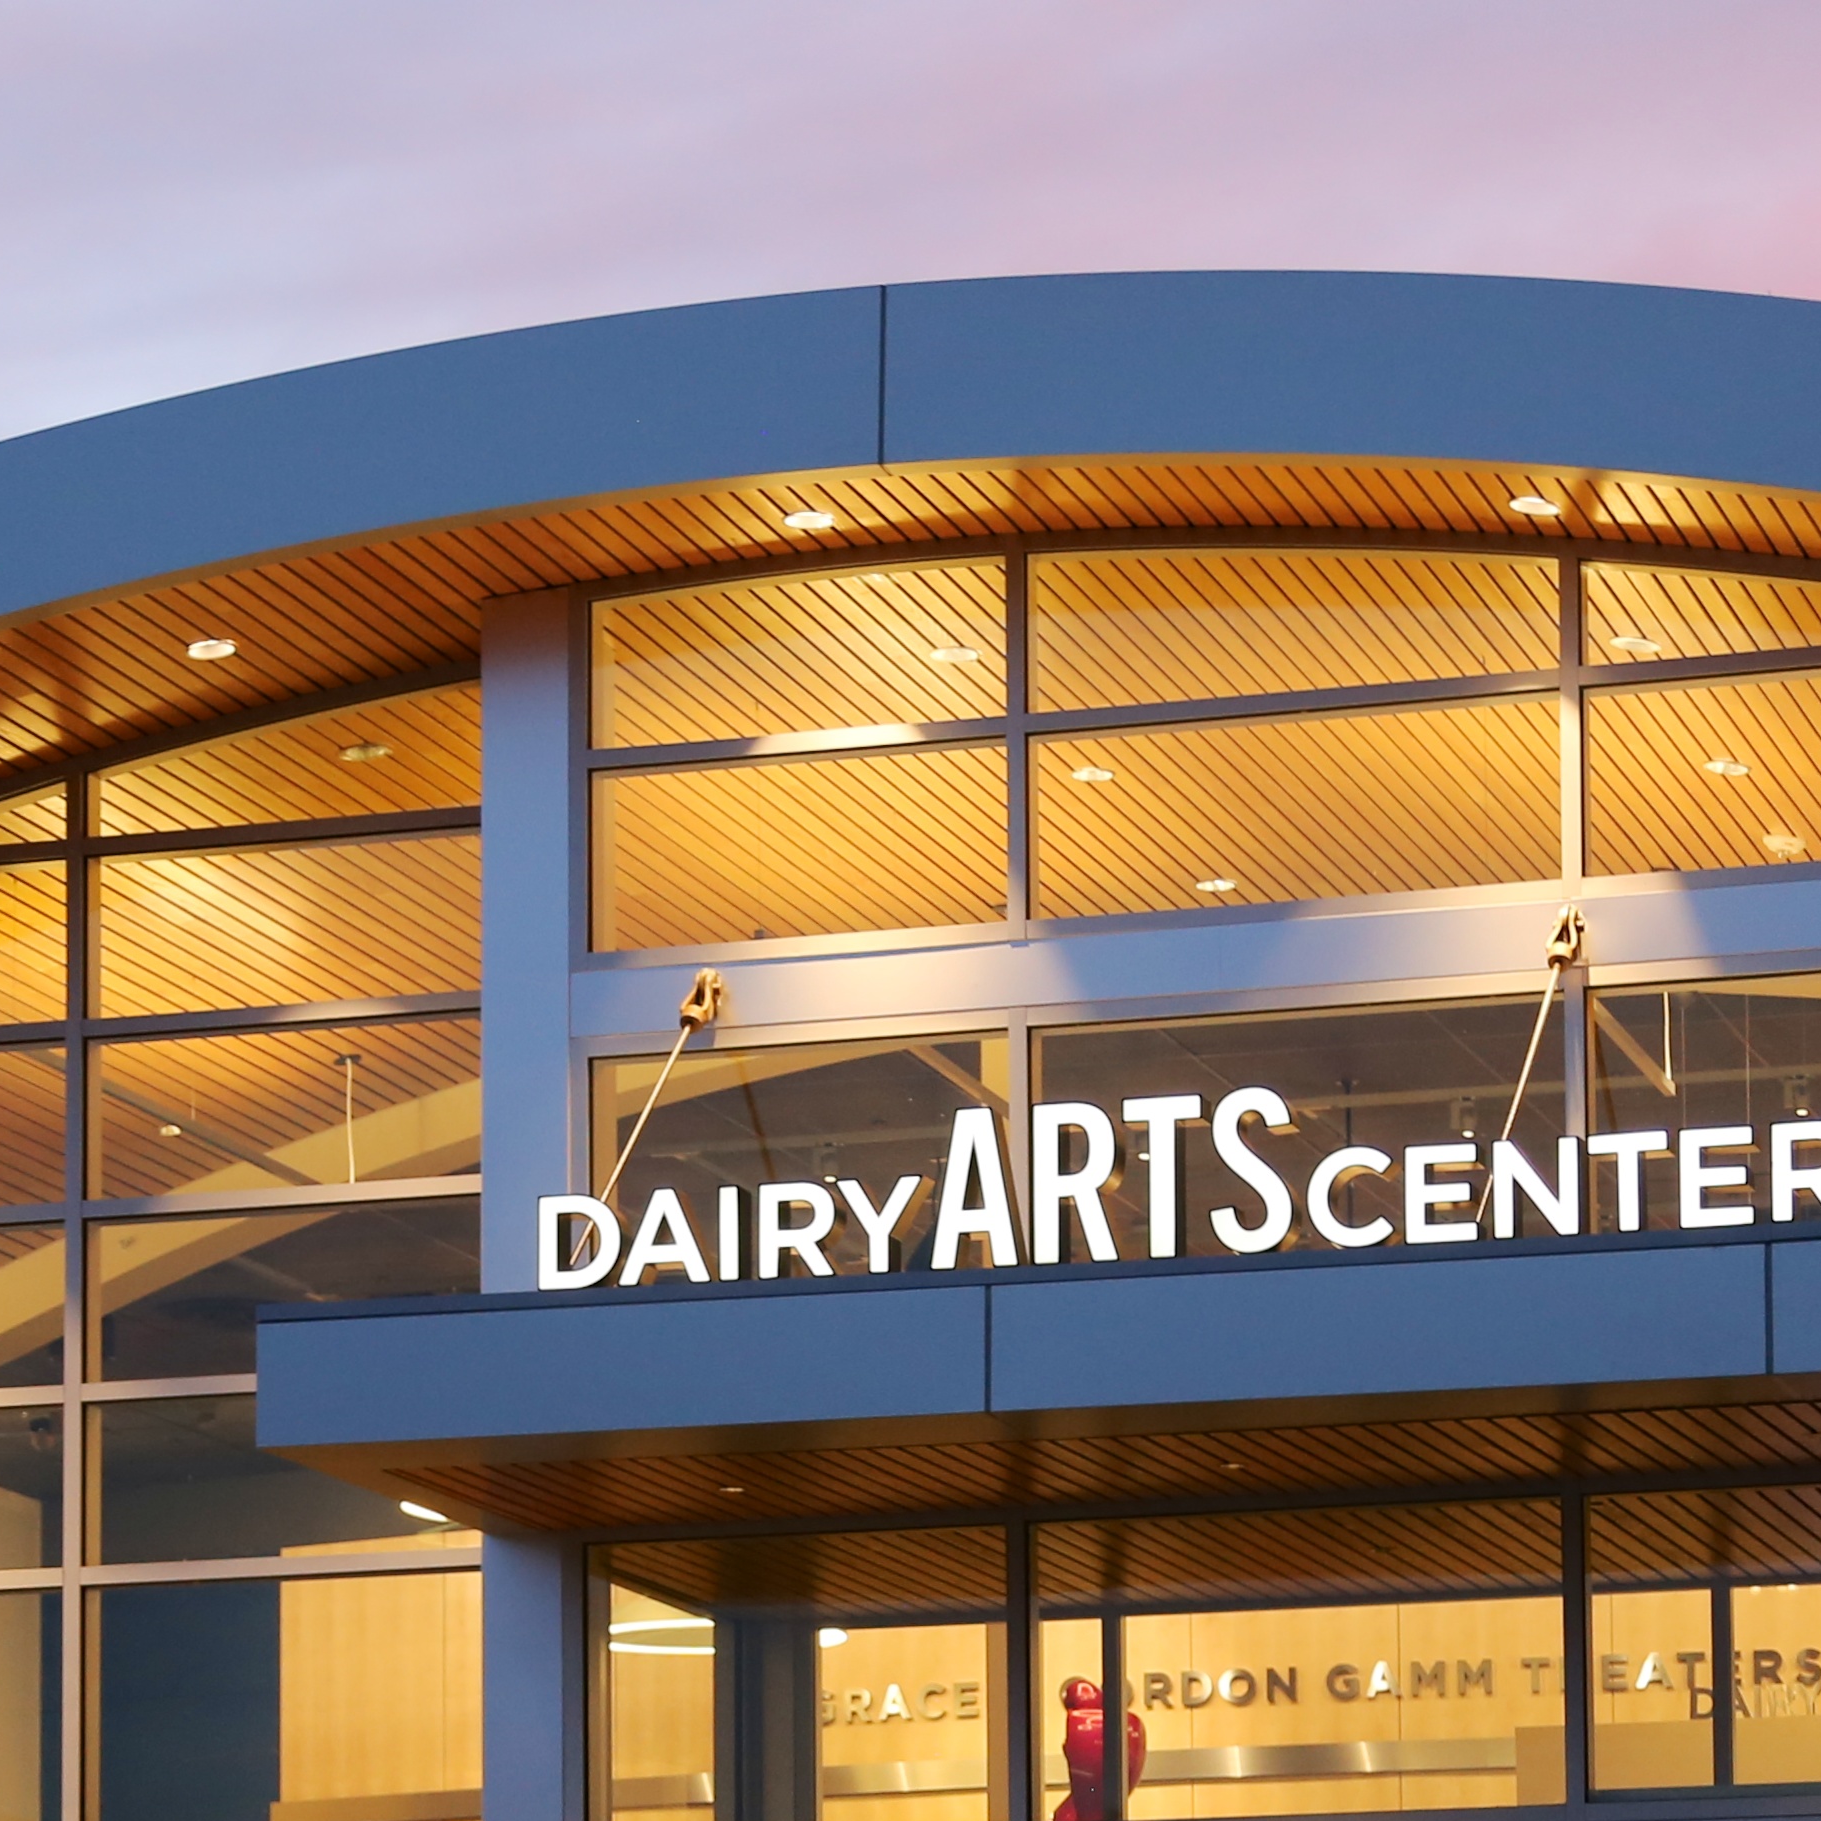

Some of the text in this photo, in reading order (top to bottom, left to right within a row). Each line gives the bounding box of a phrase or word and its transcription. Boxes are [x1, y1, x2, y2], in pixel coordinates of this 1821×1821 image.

[537, 1174, 924, 1291] DAIRY
[930, 1085, 1298, 1270] ARTS
[1326, 1659, 1493, 1703] GAMM
